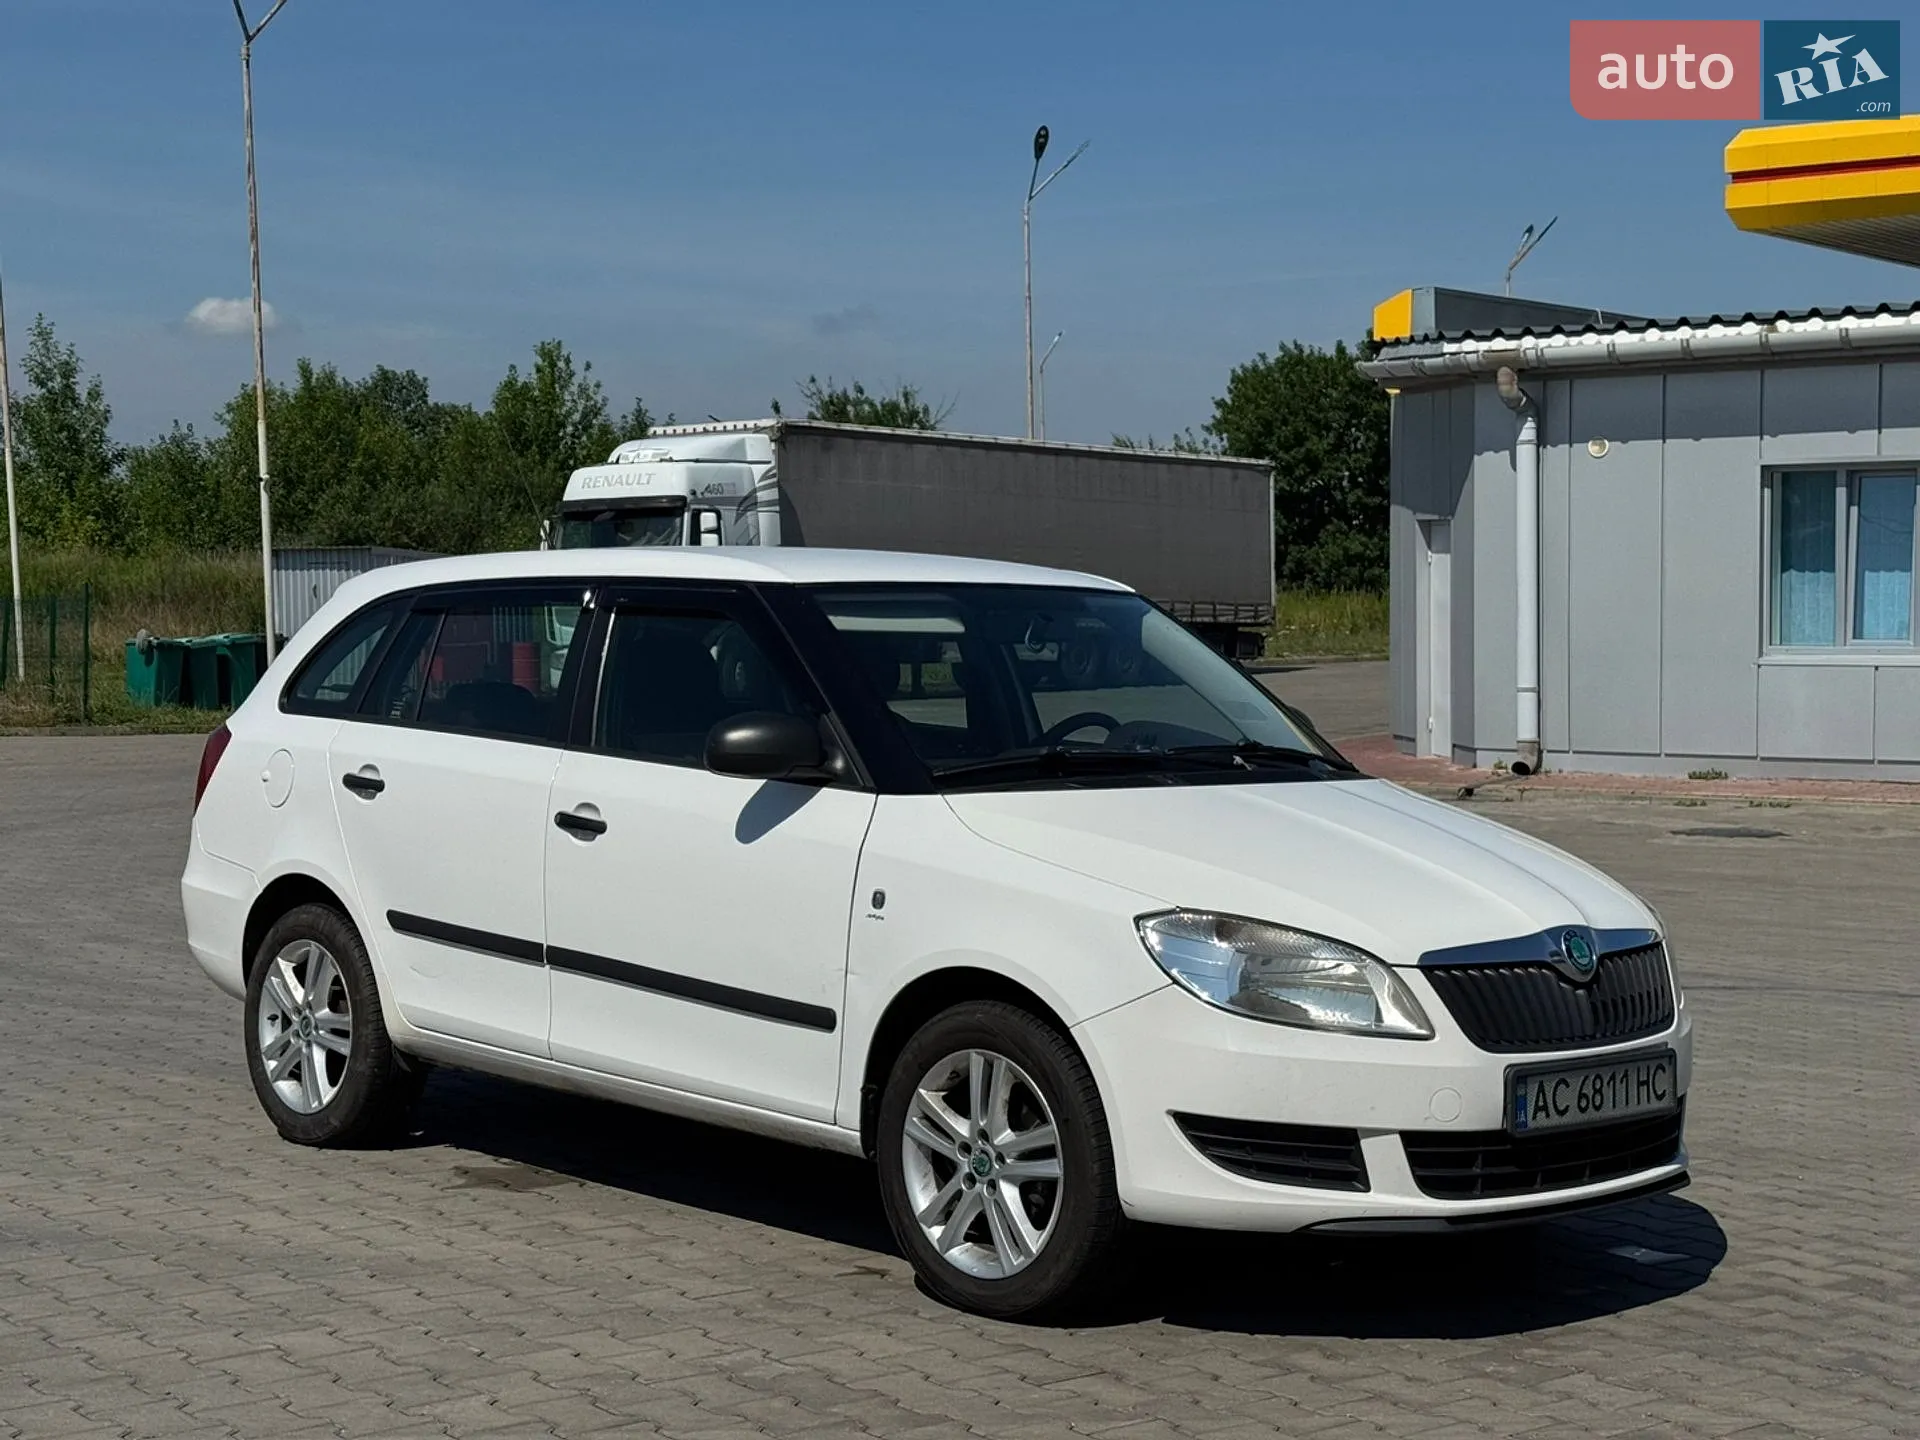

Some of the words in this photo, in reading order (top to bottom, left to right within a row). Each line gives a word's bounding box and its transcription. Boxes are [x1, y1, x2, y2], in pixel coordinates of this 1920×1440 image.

[581, 473, 656, 489] RENAULT
[1532, 1077, 1571, 1121] AC
[1577, 1068, 1630, 1114] 6811
[1636, 1062, 1667, 1106] HC
